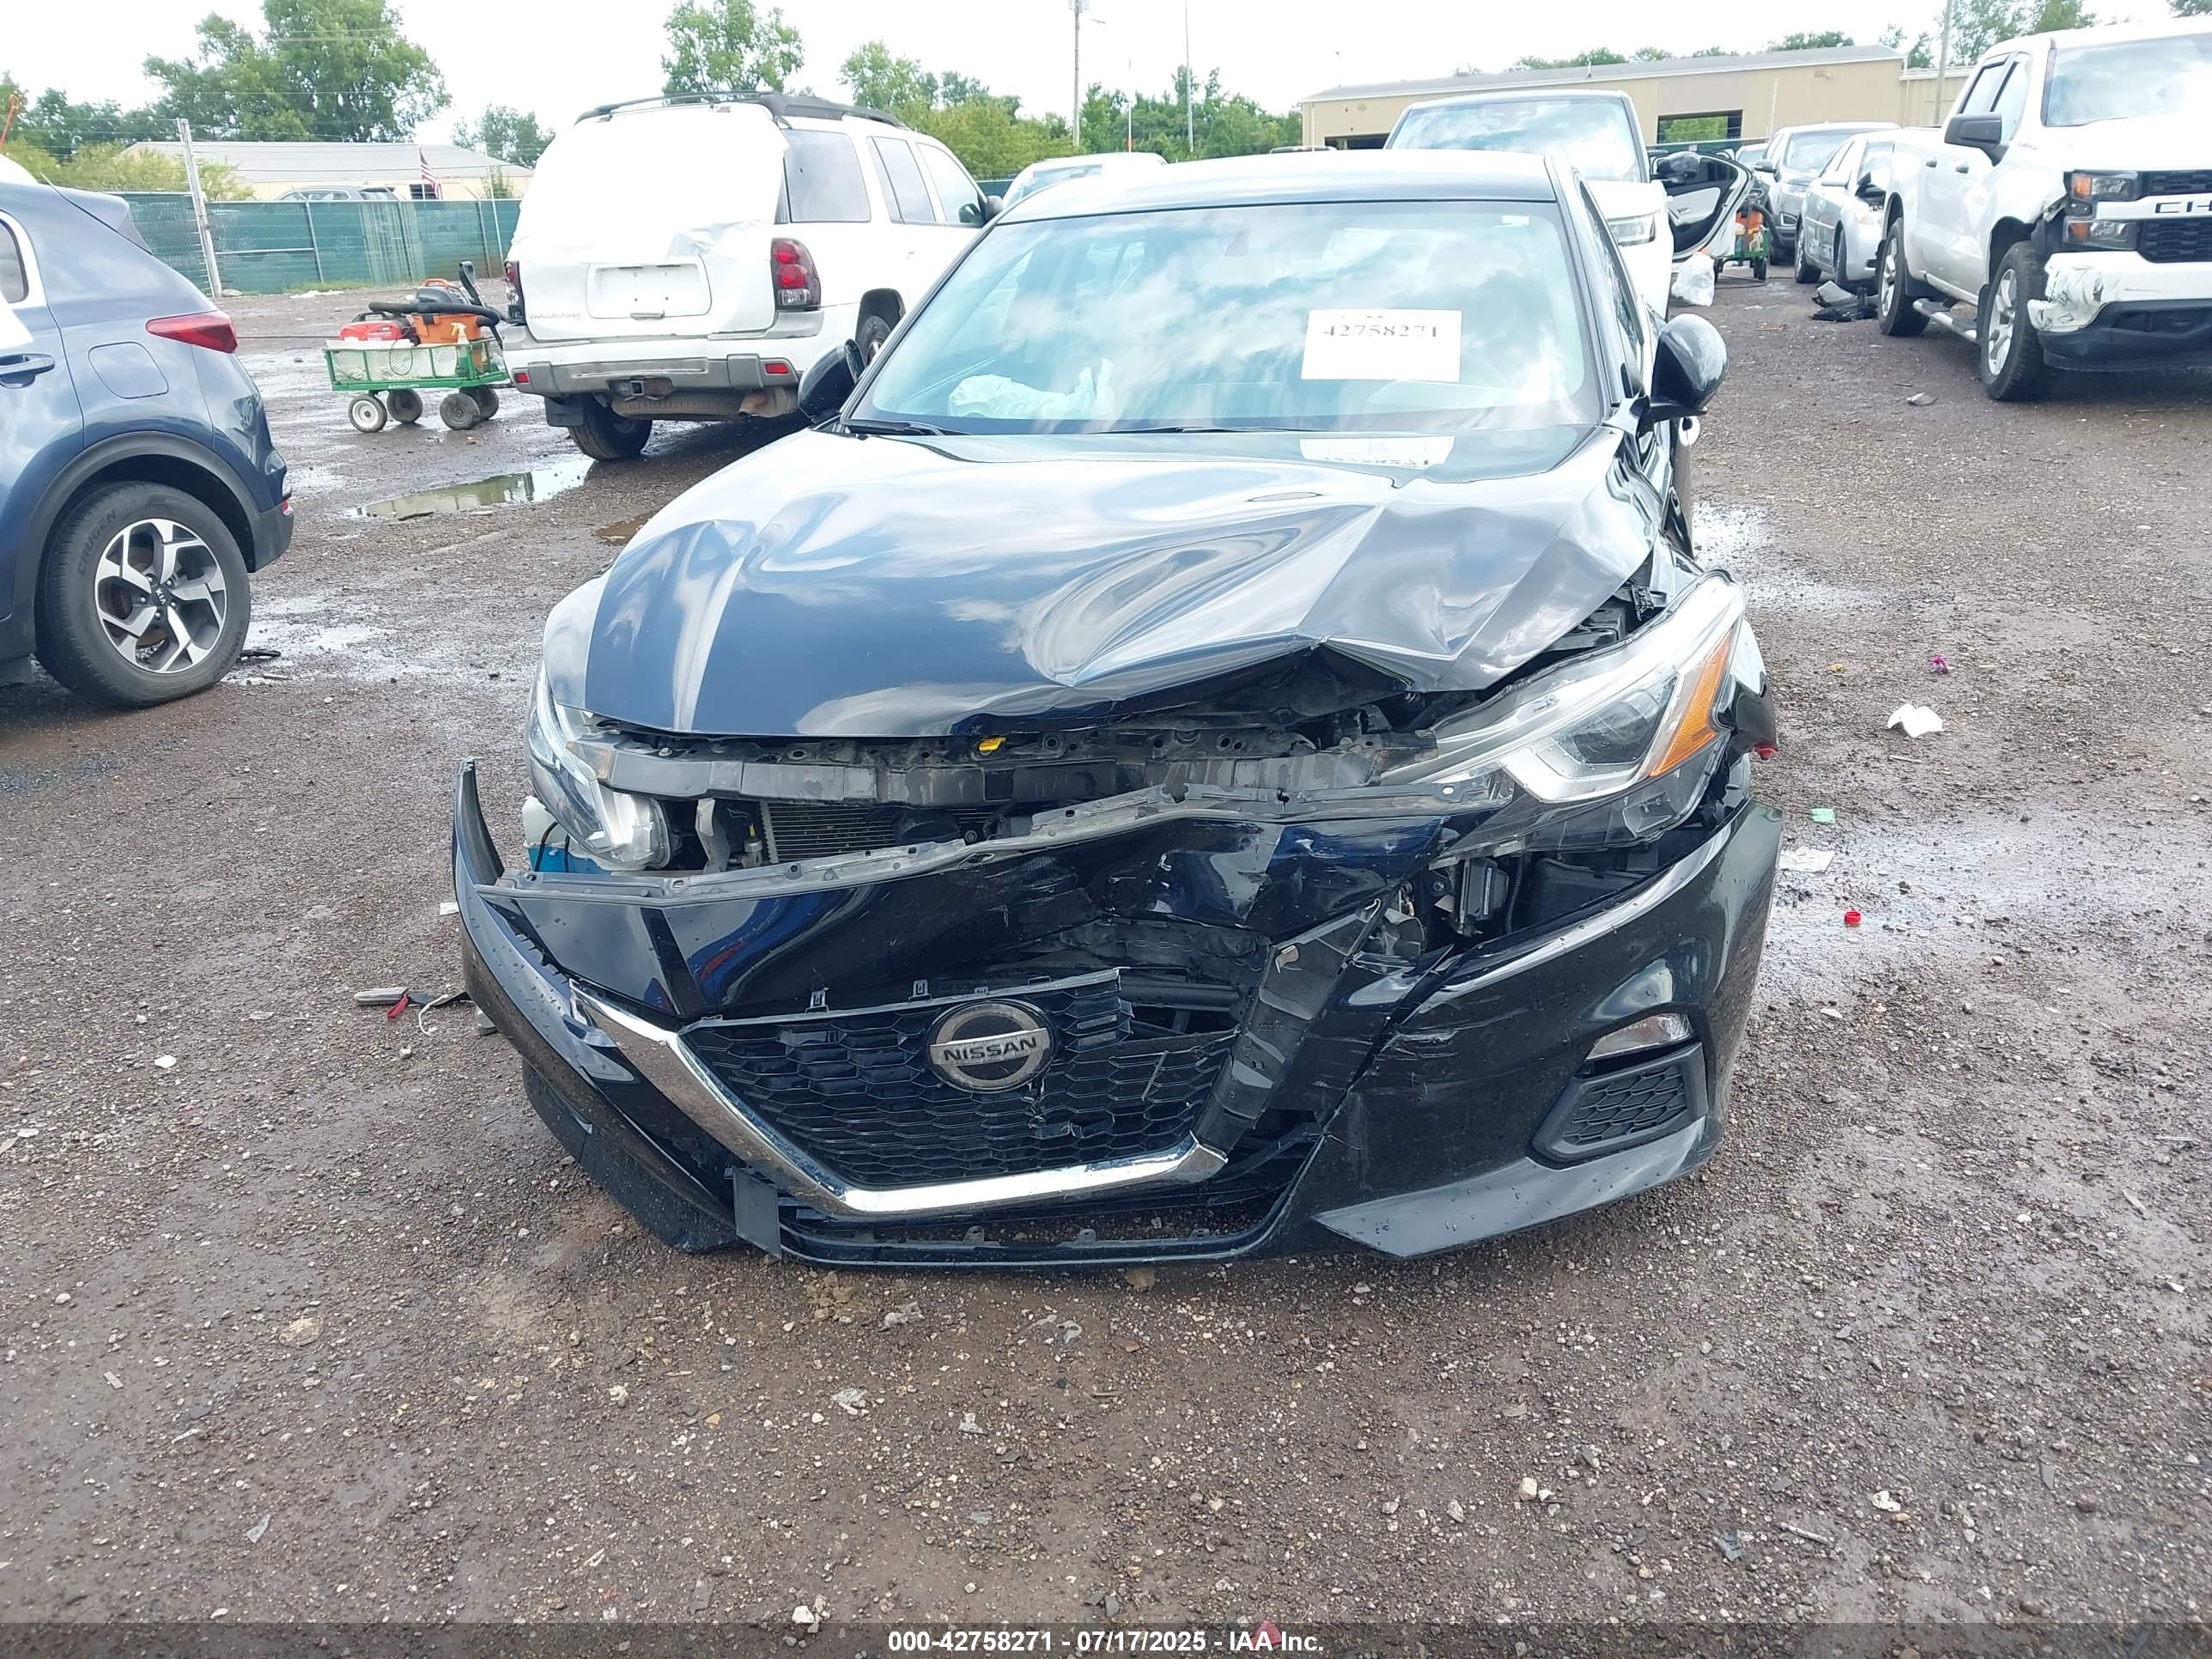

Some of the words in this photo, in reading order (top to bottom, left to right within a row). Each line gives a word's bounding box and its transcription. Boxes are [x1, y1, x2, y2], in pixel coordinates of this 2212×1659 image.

[1323, 325, 1437, 337] 42758271
[155, 587, 167, 605] KIA
[943, 1036, 1037, 1061] NISSAN
